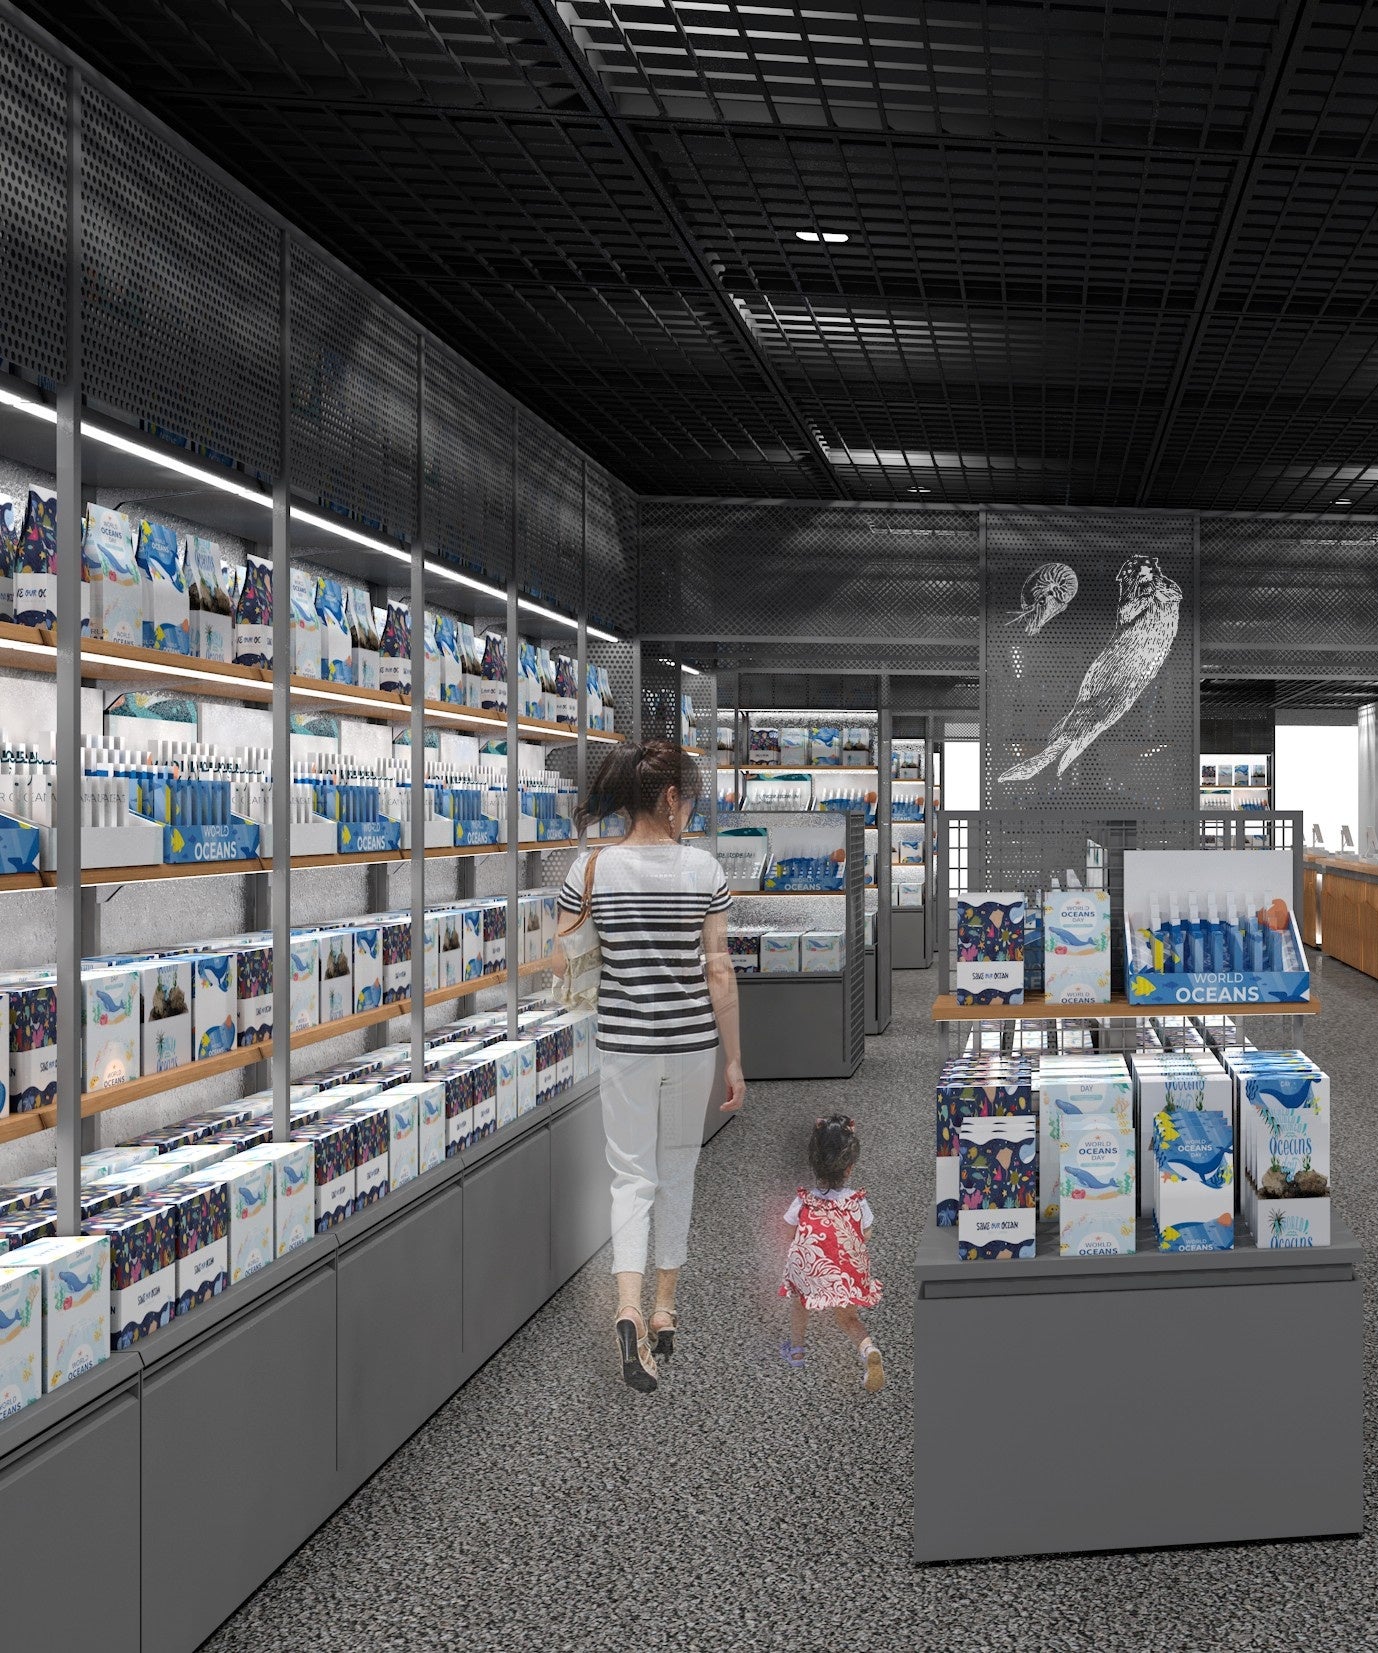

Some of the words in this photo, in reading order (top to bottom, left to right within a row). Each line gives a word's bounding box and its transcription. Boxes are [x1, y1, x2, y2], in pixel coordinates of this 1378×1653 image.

[101, 529, 122, 538] OCEANS
[152, 543, 168, 552] OCEANS
[204, 826, 229, 837] WORLD
[546, 829, 563, 840] OCEANS
[357, 836, 385, 850] OCEANS
[467, 832, 488, 844] OCEANS
[195, 841, 236, 860] OCEANS
[972, 972, 984, 980] SAVE
[1193, 973, 1244, 983] WORLD
[1176, 987, 1259, 1003] OCEANS
[104, 1076, 125, 1088] OCEANS
[1270, 1136, 1311, 1155] Oceans
[976, 1222, 990, 1230] SAVE
[289, 1238, 304, 1250] OCEANS
[245, 1262, 262, 1277] OCEANS
[72, 1355, 89, 1368] WORLD
[68, 1361, 93, 1380] OCEANS
